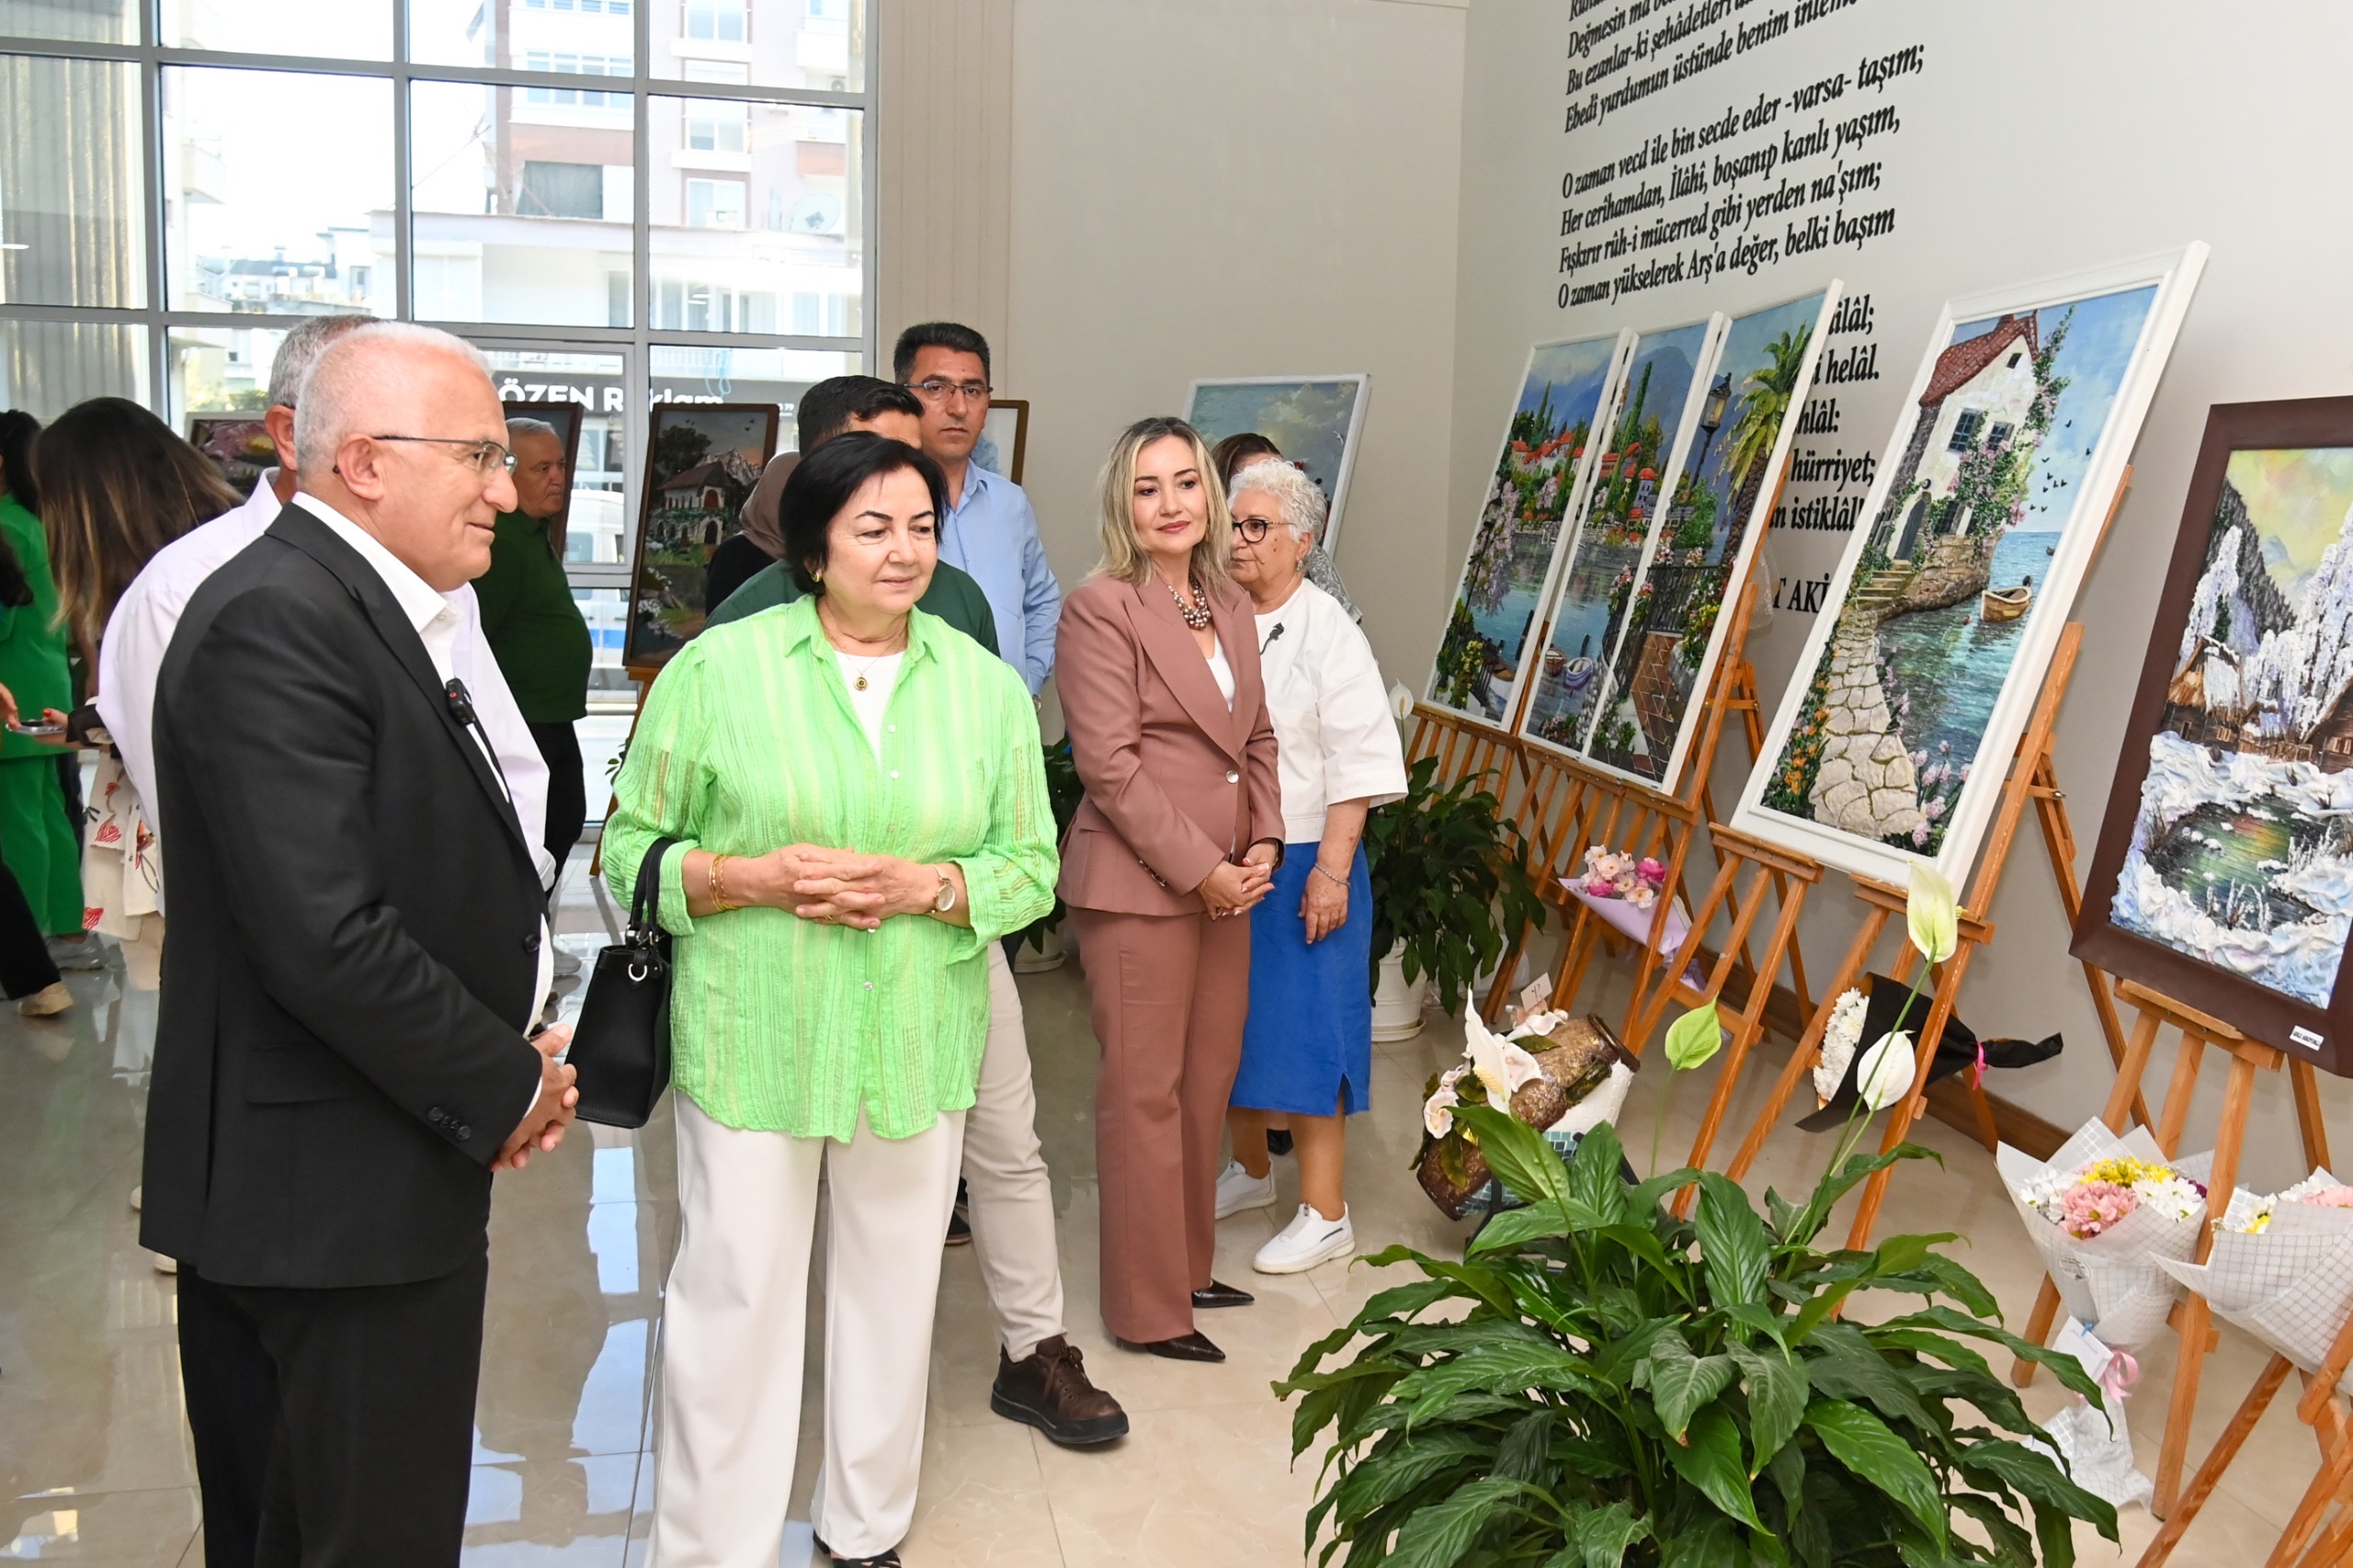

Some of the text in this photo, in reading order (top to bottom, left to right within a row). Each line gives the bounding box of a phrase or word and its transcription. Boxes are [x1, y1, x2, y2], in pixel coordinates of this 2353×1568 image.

[1565, 69, 1583, 96] Bu
[1585, 28, 1649, 86] ezanlar-ki
[1567, 6, 1626, 59] Değmesin
[1564, 93, 1598, 133] Ebedî
[1597, 67, 1669, 127] yurdumun
[1673, 29, 1733, 85] üstünde
[1736, 9, 1790, 55] benim
[1562, 44, 1925, 199] O zaman vecd ile bin secde eder -varsa- taşım;
[1560, 208, 1583, 237] Her
[1585, 181, 1665, 229] cerîhamdan,
[1712, 143, 1778, 191] boşanıp
[1781, 118, 1830, 165] kanlı
[1831, 105, 1901, 160] yaşım,
[1558, 207, 1896, 310] O zaman yükselerek Arş'a değer, belki başım
[1559, 241, 1603, 278] Fışkırır
[1640, 201, 1709, 251] mücerred
[1709, 193, 1744, 241] gibi
[1743, 177, 1806, 233] yerden
[497, 378, 595, 412] ÖZEN
[1825, 343, 1880, 385] helâl.
[1793, 397, 1840, 435] hlâl:
[1790, 448, 1876, 494] hürriyet;
